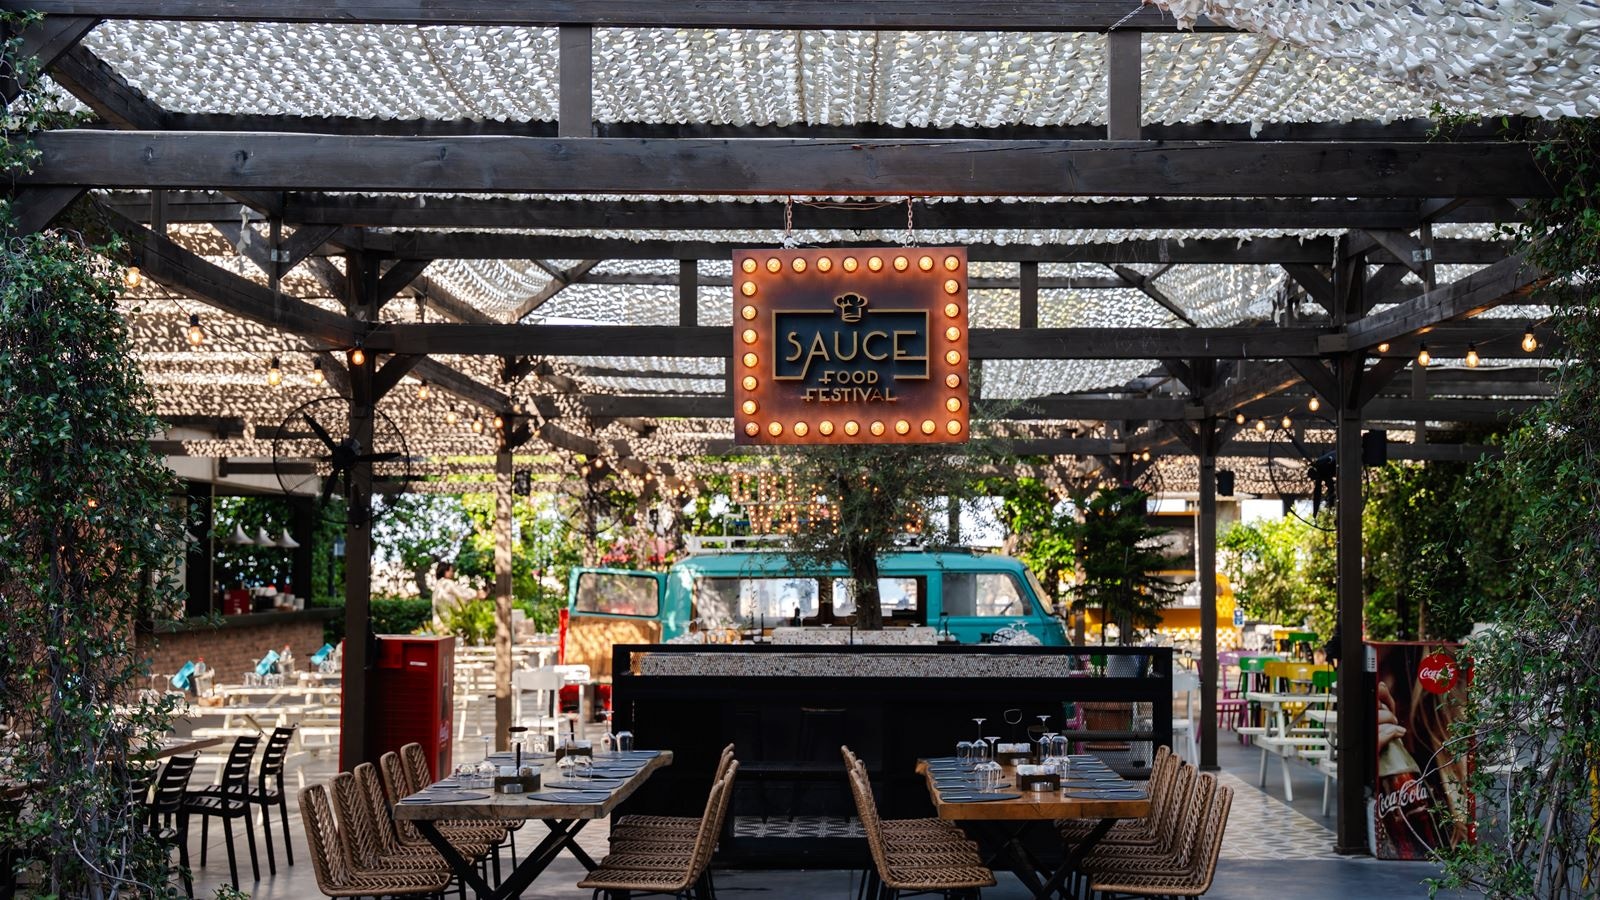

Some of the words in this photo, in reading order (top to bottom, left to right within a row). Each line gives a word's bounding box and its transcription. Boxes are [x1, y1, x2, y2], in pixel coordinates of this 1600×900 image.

[785, 330, 917, 362] SAUCE
[819, 370, 879, 385] FOOD
[801, 387, 897, 402] FESTIVAL
[1378, 779, 1428, 818] Coca-Cola
